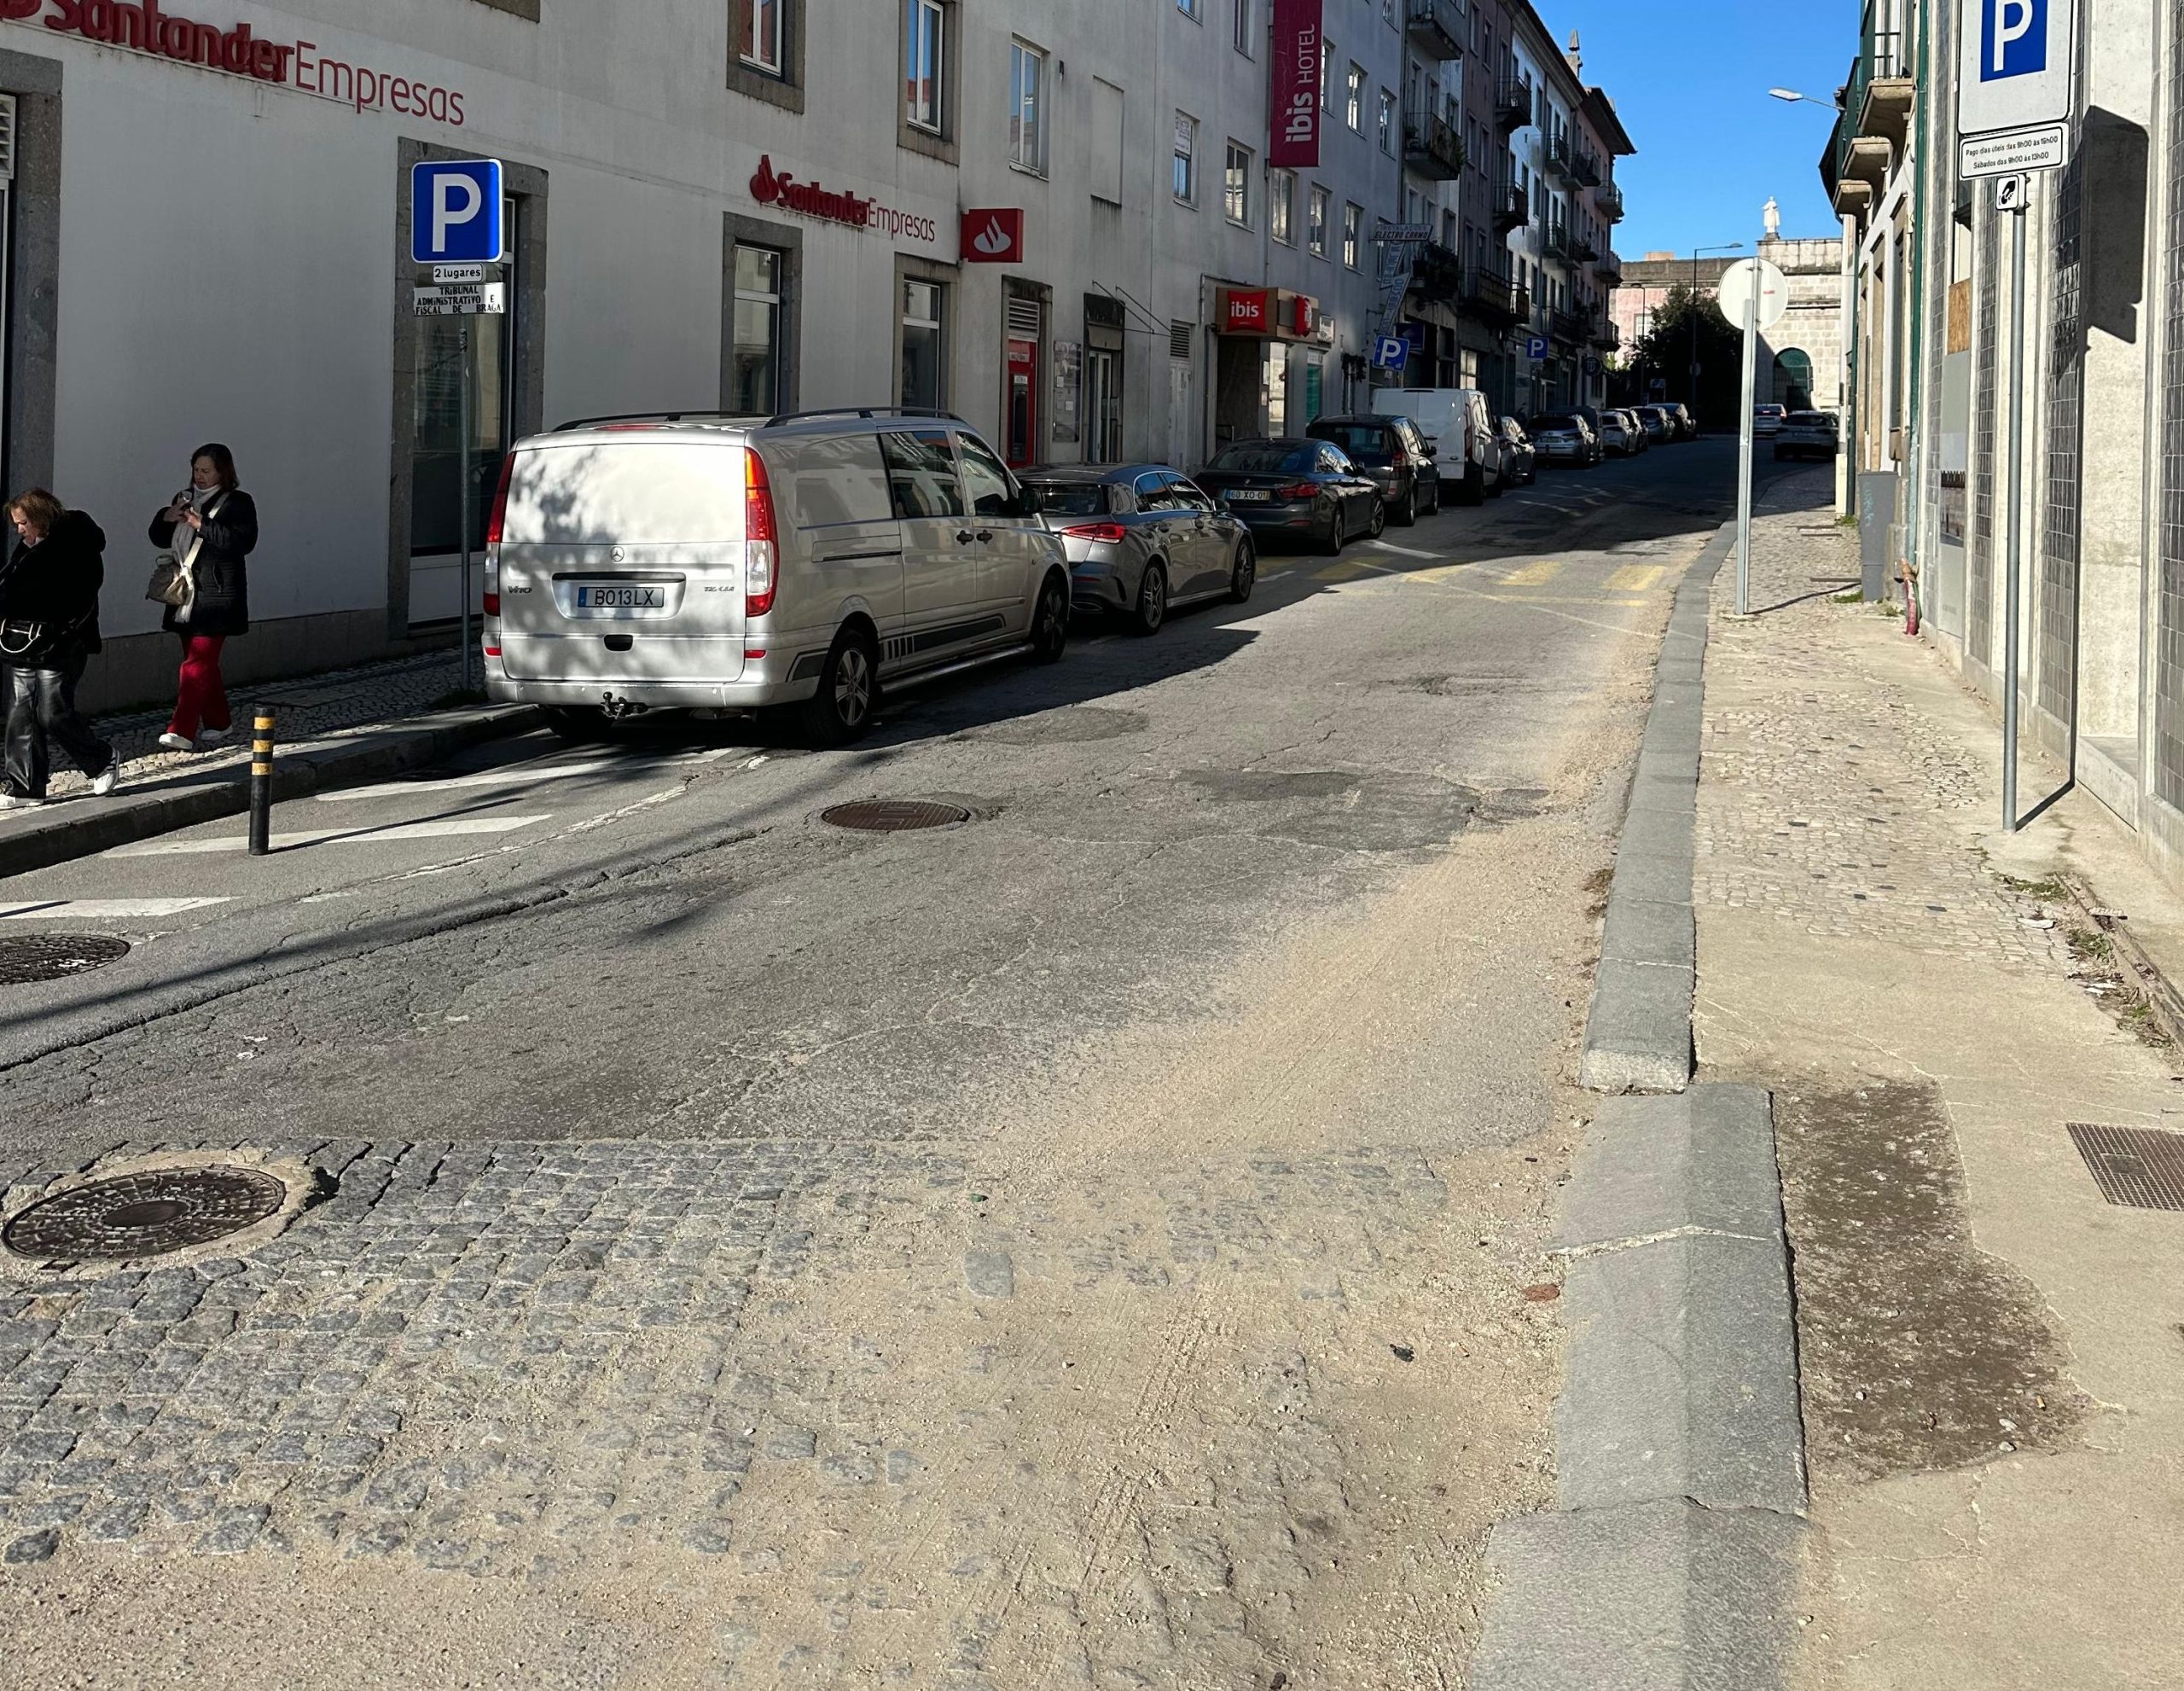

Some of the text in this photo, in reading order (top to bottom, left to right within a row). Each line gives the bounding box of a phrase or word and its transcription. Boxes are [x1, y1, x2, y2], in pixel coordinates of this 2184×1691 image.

[1993, 0, 2033, 72] P
[296, 40, 465, 126] Empresas
[1286, 23, 1316, 142] ibis HOTEL
[432, 173, 481, 252] P
[777, 172, 935, 242] Santander Empresas
[434, 268, 481, 279] 2 lugares
[452, 305, 462, 313] DE
[1231, 301, 1259, 317] ibis
[1380, 339, 1402, 366] P
[1531, 339, 1544, 357] P
